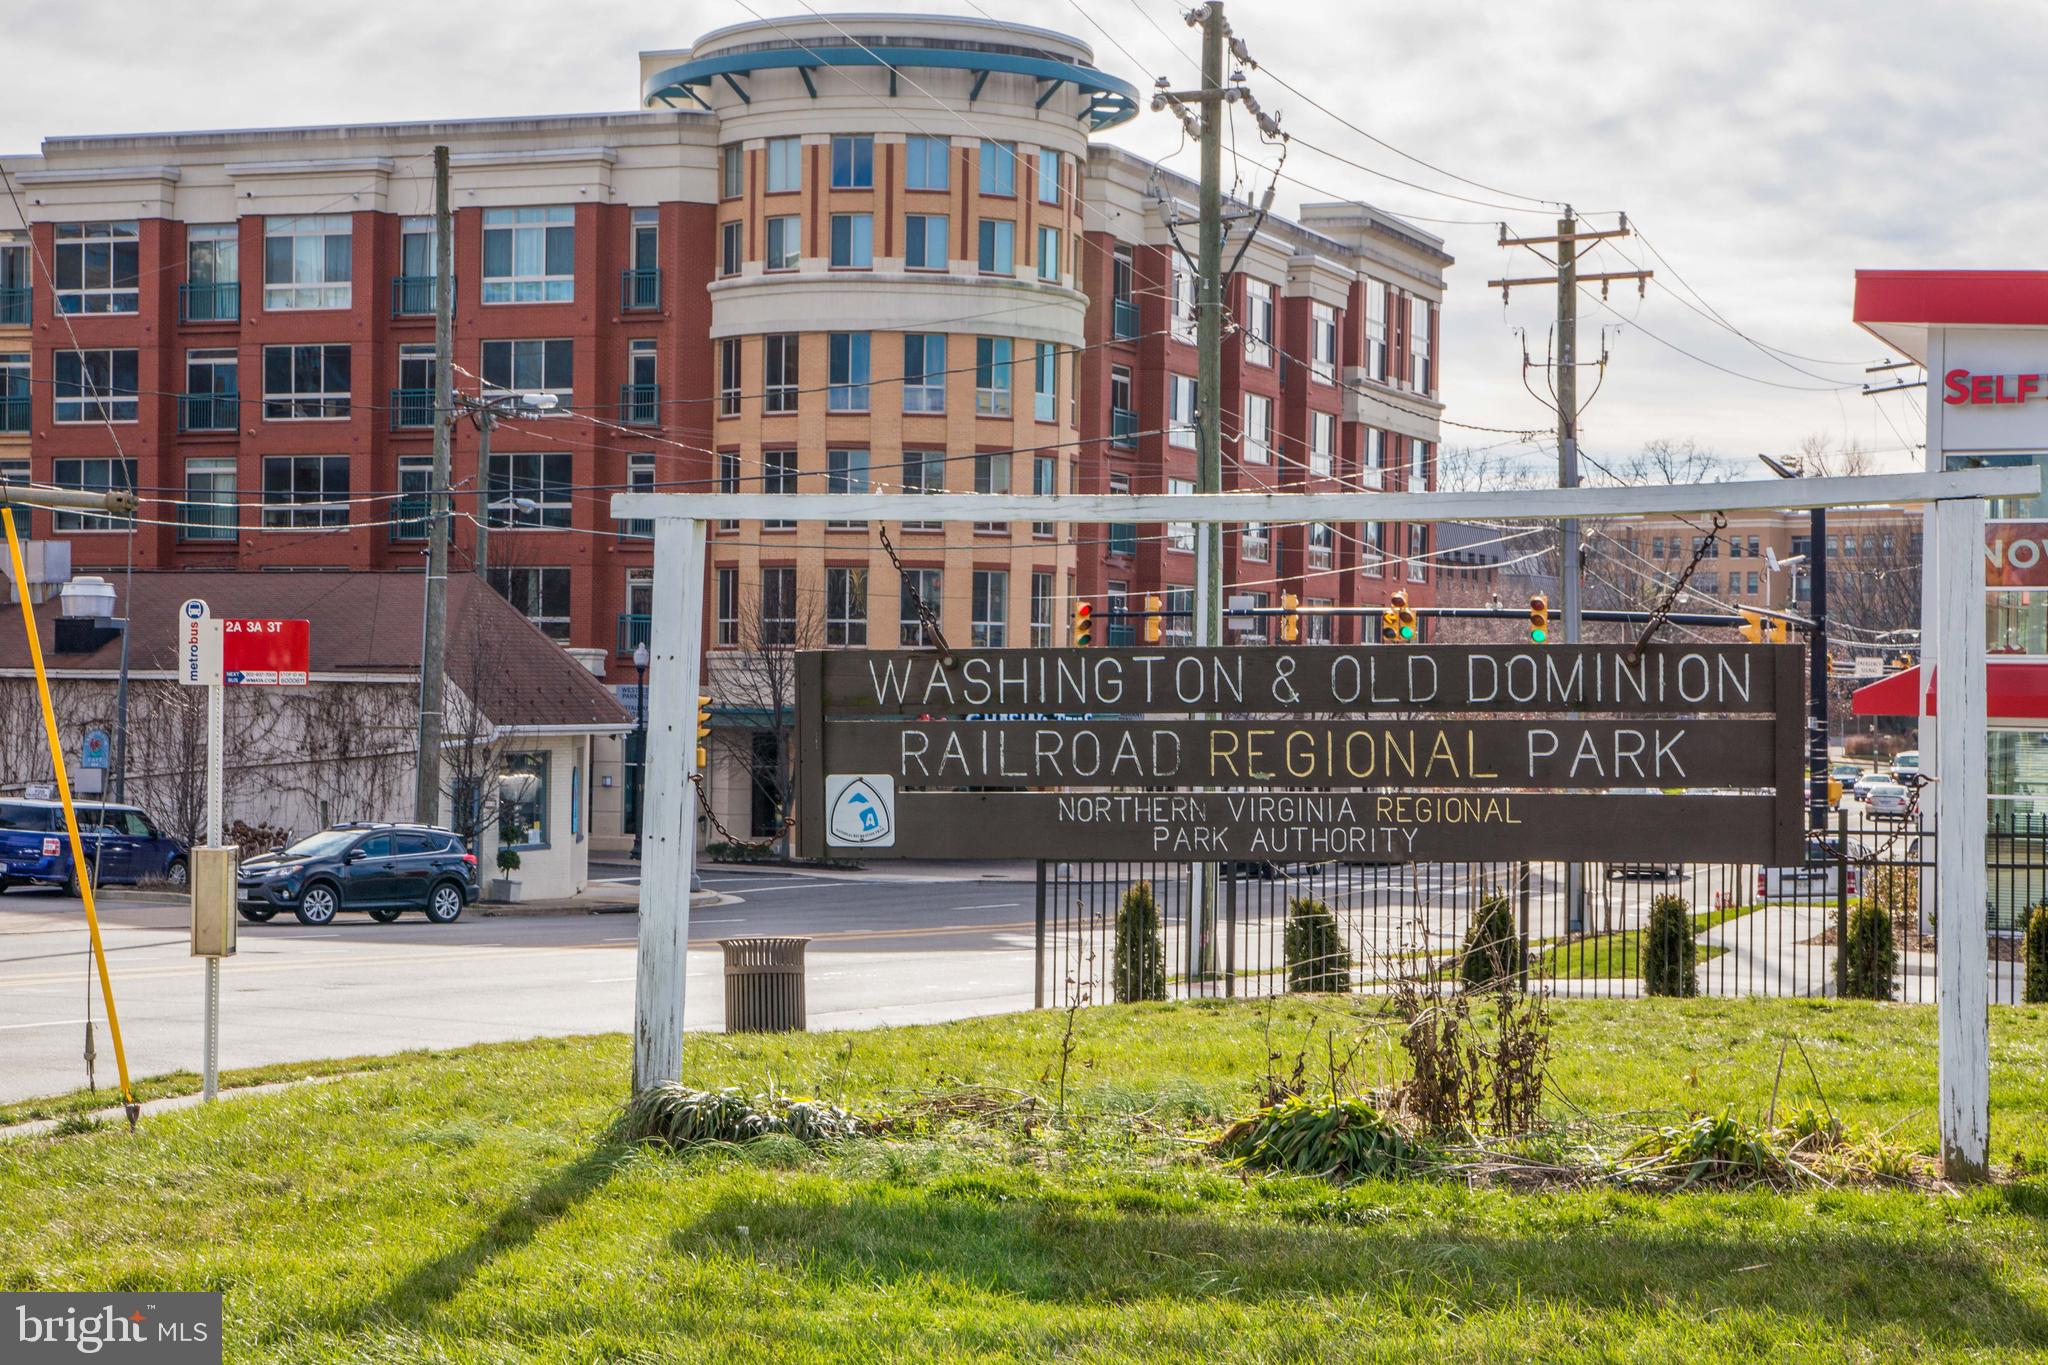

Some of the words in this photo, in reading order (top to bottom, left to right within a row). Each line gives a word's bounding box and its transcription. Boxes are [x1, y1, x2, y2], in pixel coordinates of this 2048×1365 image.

[1944, 369, 2040, 405] SELF
[1984, 538, 2048, 569] NO
[226, 622, 242, 632] 2A
[246, 622, 262, 632] 3A
[267, 622, 283, 632] 3T
[188, 621, 199, 681] metrobus
[869, 655, 1243, 705] WASHINGTON
[1272, 655, 1301, 706] &
[1331, 655, 1439, 703] OLD
[1468, 653, 1750, 703] DOMINION
[902, 731, 1181, 777] RAILROAD
[1210, 730, 1498, 778] REGIONAL
[1527, 729, 1686, 778] PARK
[1058, 796, 1207, 823] NORTHERN
[1227, 796, 1356, 823] VIRGINIA
[1376, 797, 1522, 824] REGIONAL
[1153, 827, 1229, 852] PARK
[1250, 827, 1419, 853] AUTHORITY
